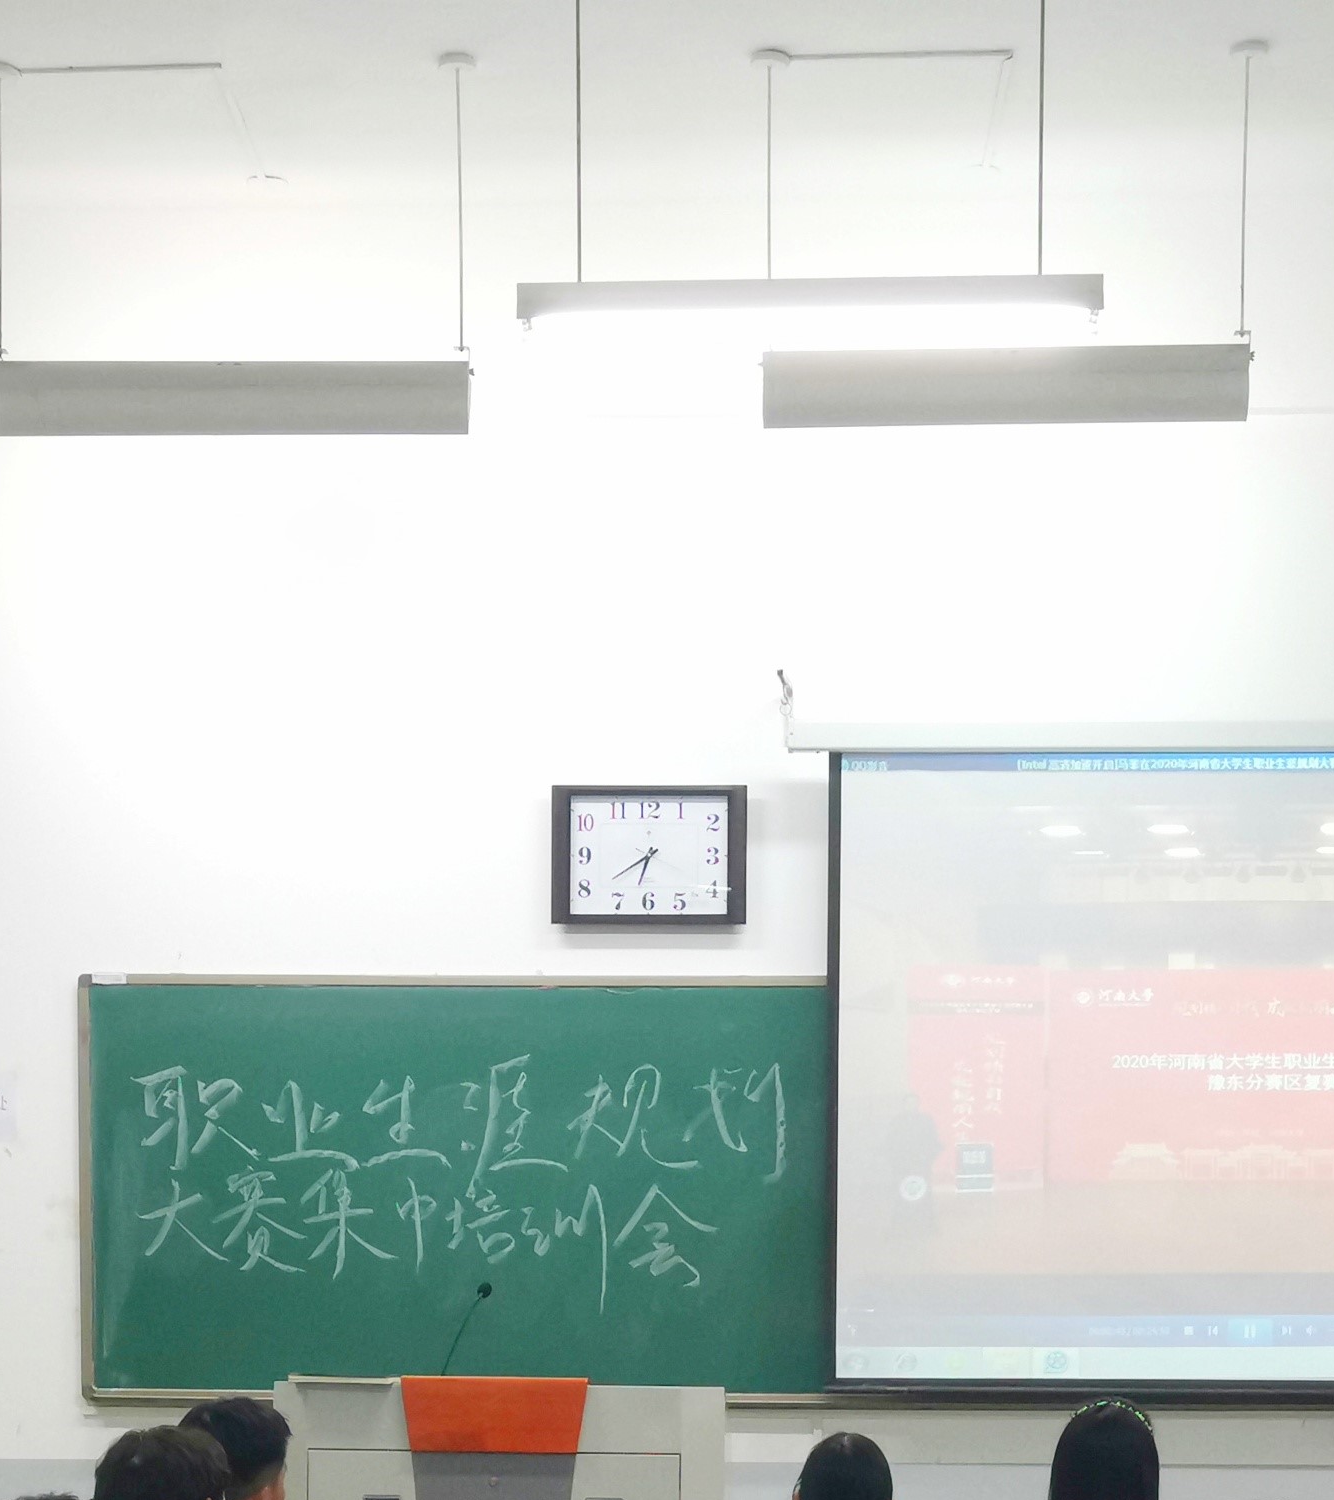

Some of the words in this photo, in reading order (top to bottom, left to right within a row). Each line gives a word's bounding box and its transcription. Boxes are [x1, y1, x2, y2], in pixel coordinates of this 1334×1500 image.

[610, 802, 626, 819] 11
[638, 801, 661, 819] 12
[677, 802, 684, 819] 1
[577, 814, 594, 831] 10
[706, 814, 720, 831] 2
[578, 846, 592, 865] 9
[706, 847, 719, 865] 3
[578, 879, 592, 898] 8
[705, 880, 719, 898] 4
[611, 892, 625, 910] 7
[641, 892, 655, 911] 6
[673, 892, 686, 911] 5
[131, 1054, 787, 1184] 职业生涯规划
[137, 1167, 718, 1314] 大赛集中培训会
